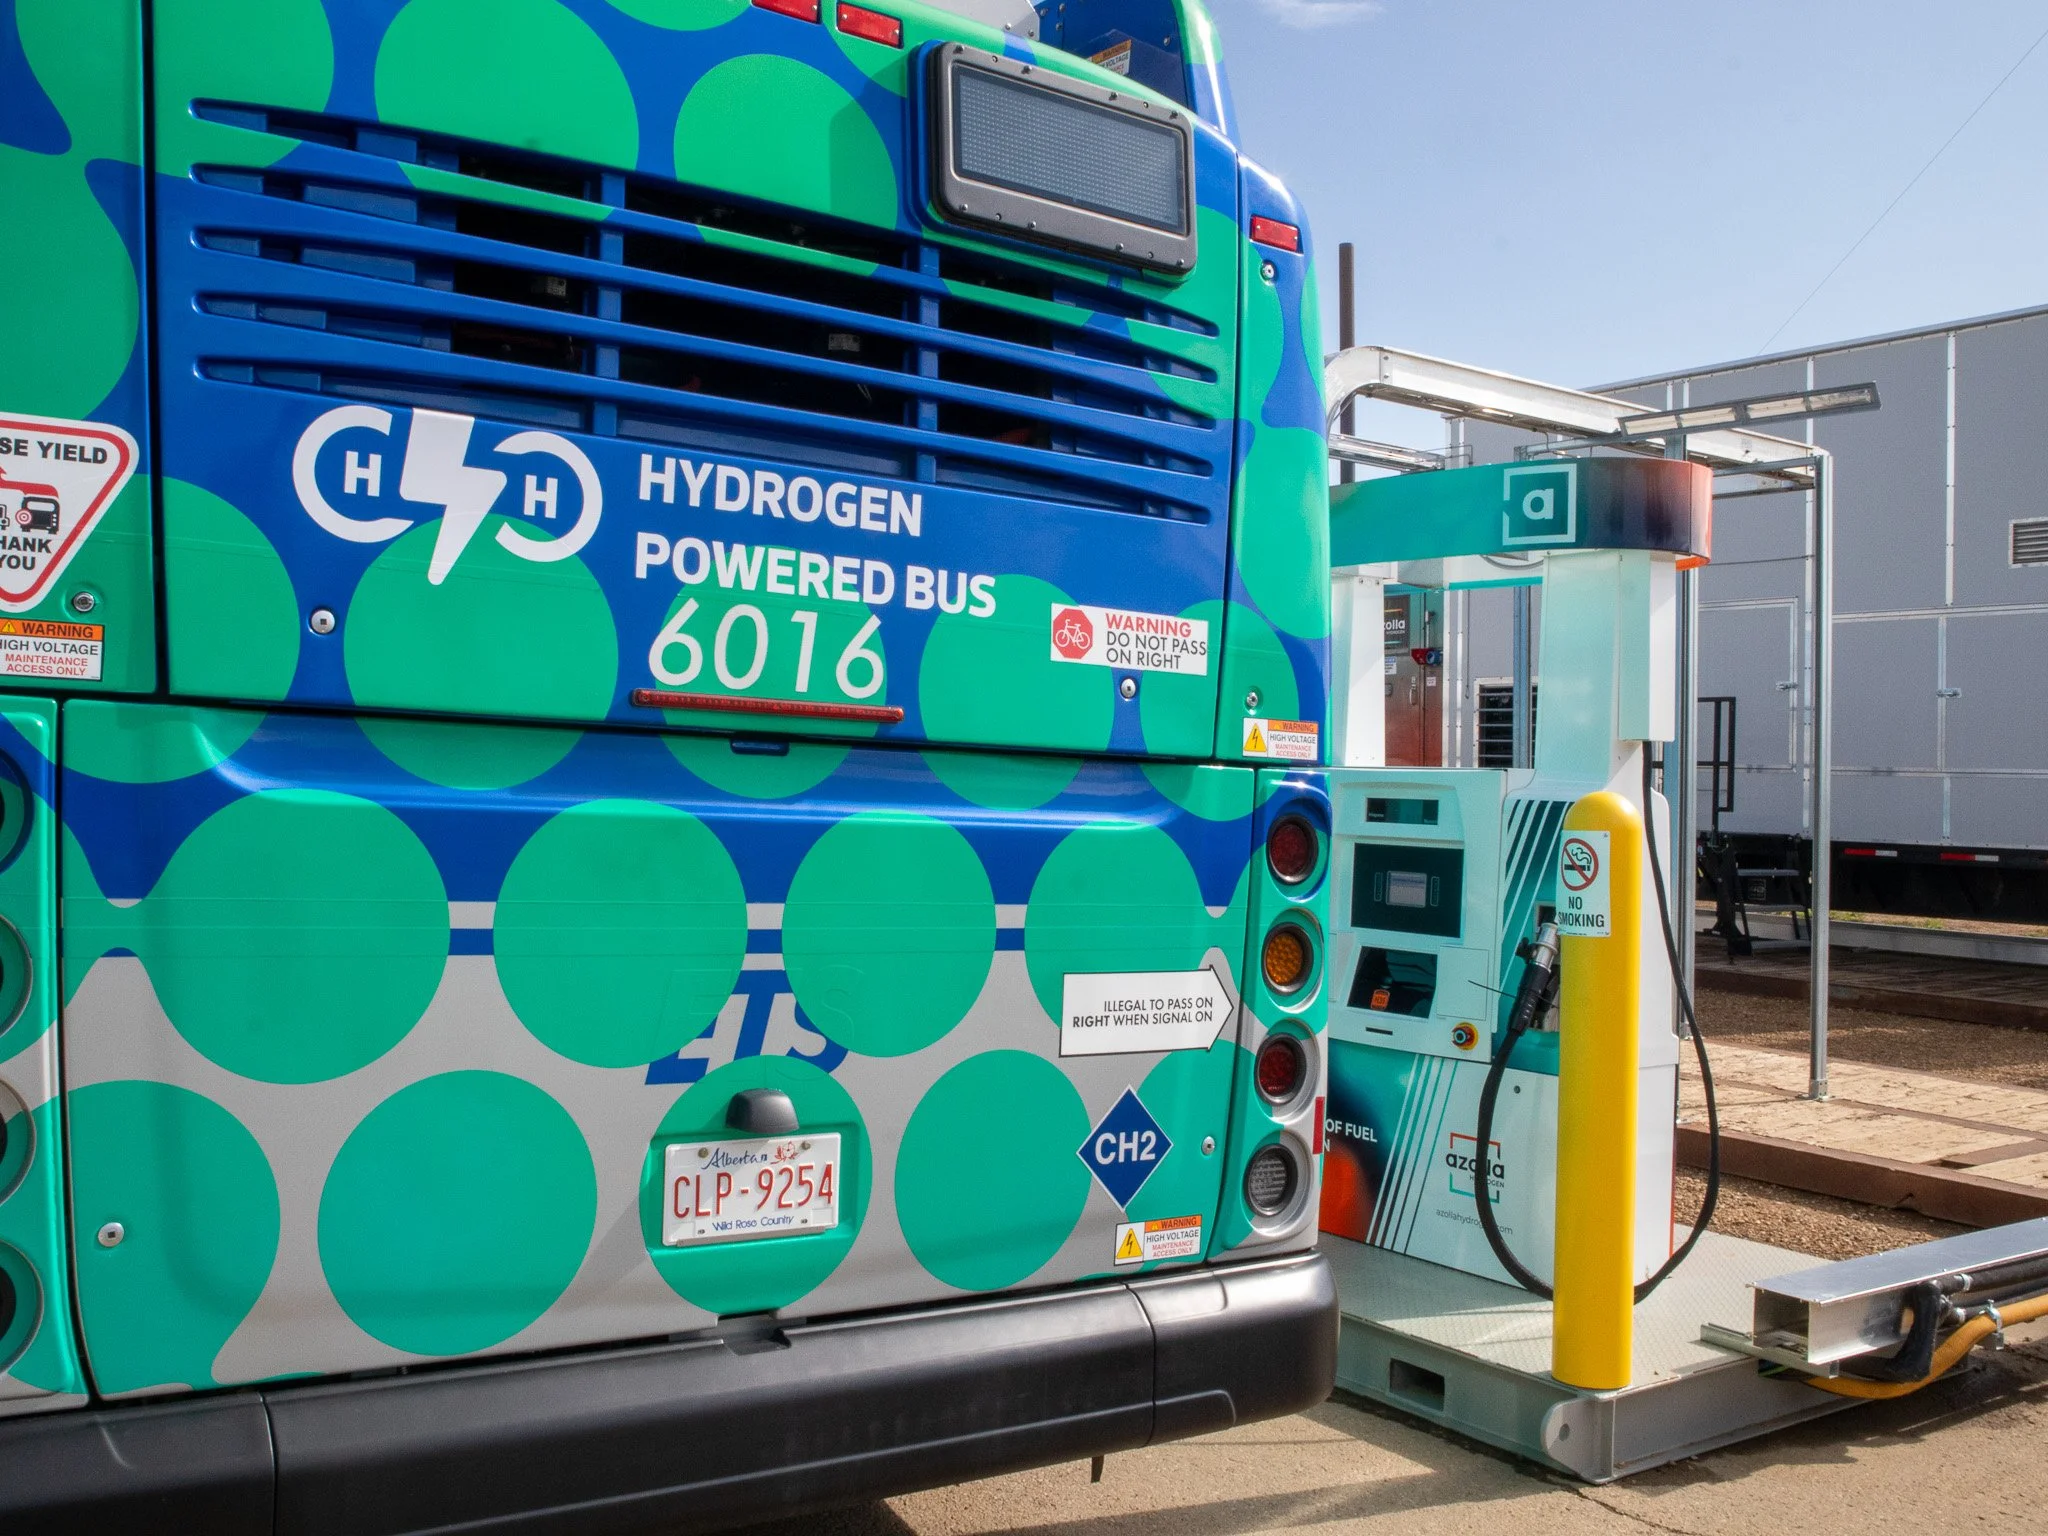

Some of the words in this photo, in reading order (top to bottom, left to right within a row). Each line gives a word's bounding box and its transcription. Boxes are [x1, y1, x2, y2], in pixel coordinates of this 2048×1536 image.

[37, 441, 107, 464] YIELD
[639, 453, 922, 537] HYDROGEN
[1522, 487, 1555, 520] a
[635, 531, 895, 605] POWERED
[906, 565, 997, 618] BUS
[22, 622, 94, 638] WARNING
[1105, 613, 1192, 637] WARNING
[1384, 619, 1406, 631] olla
[0, 639, 29, 651] IGH
[33, 642, 99, 656] VOLTAGE
[648, 597, 885, 699] 6016
[1106, 631, 1130, 647] DO
[1135, 634, 1168, 652] NOT
[1172, 639, 1207, 655] PASS
[5, 653, 88, 667] MAINTENANCE
[1106, 648, 1131, 664] ON
[1137, 651, 1181, 669] RIGHT
[6, 664, 53, 675] ACCESS
[56, 666, 86, 676] ONLY
[1283, 722, 1314, 733] WARNING
[1270, 733, 1287, 742] HIGH
[1287, 735, 1316, 745] VOLTAGE
[1275, 743, 1312, 752] MAINTENANCE
[1275, 750, 1297, 758] ACCESS
[1568, 896, 1583, 910] NO
[1558, 911, 1605, 928] SMOKING
[1103, 1000, 1146, 1012] ILLEGAL
[1150, 999, 1165, 1011] TO
[1167, 998, 1193, 1010] PASS
[1195, 997, 1213, 1009] ON
[645, 969, 850, 1085] TS
[1072, 1015, 1110, 1028] RIGHT
[1113, 1014, 1149, 1026] WHEN
[1152, 1012, 1193, 1025] SIGNAL
[1195, 1011, 1213, 1022] ON
[1325, 1118, 1343, 1134] OF
[1345, 1122, 1378, 1143] FUEL
[1095, 1130, 1157, 1165] CH2
[701, 1147, 757, 1170] Alberta
[1445, 1153, 1505, 1179] azola
[1469, 1174, 1505, 1189] HOGEN
[674, 1163, 833, 1219] CLP-9254
[712, 1219, 733, 1231] Wild
[735, 1219, 758, 1230] Rose
[761, 1215, 794, 1227] Country
[1161, 1217, 1197, 1229] WARNING
[1146, 1234, 1165, 1243] HIGH
[1166, 1229, 1199, 1240] VOLTAGE
[1152, 1240, 1194, 1250] MAINTENANCE
[1153, 1249, 1177, 1258] ACCESS
[1177, 1247, 1193, 1256] ONLY
